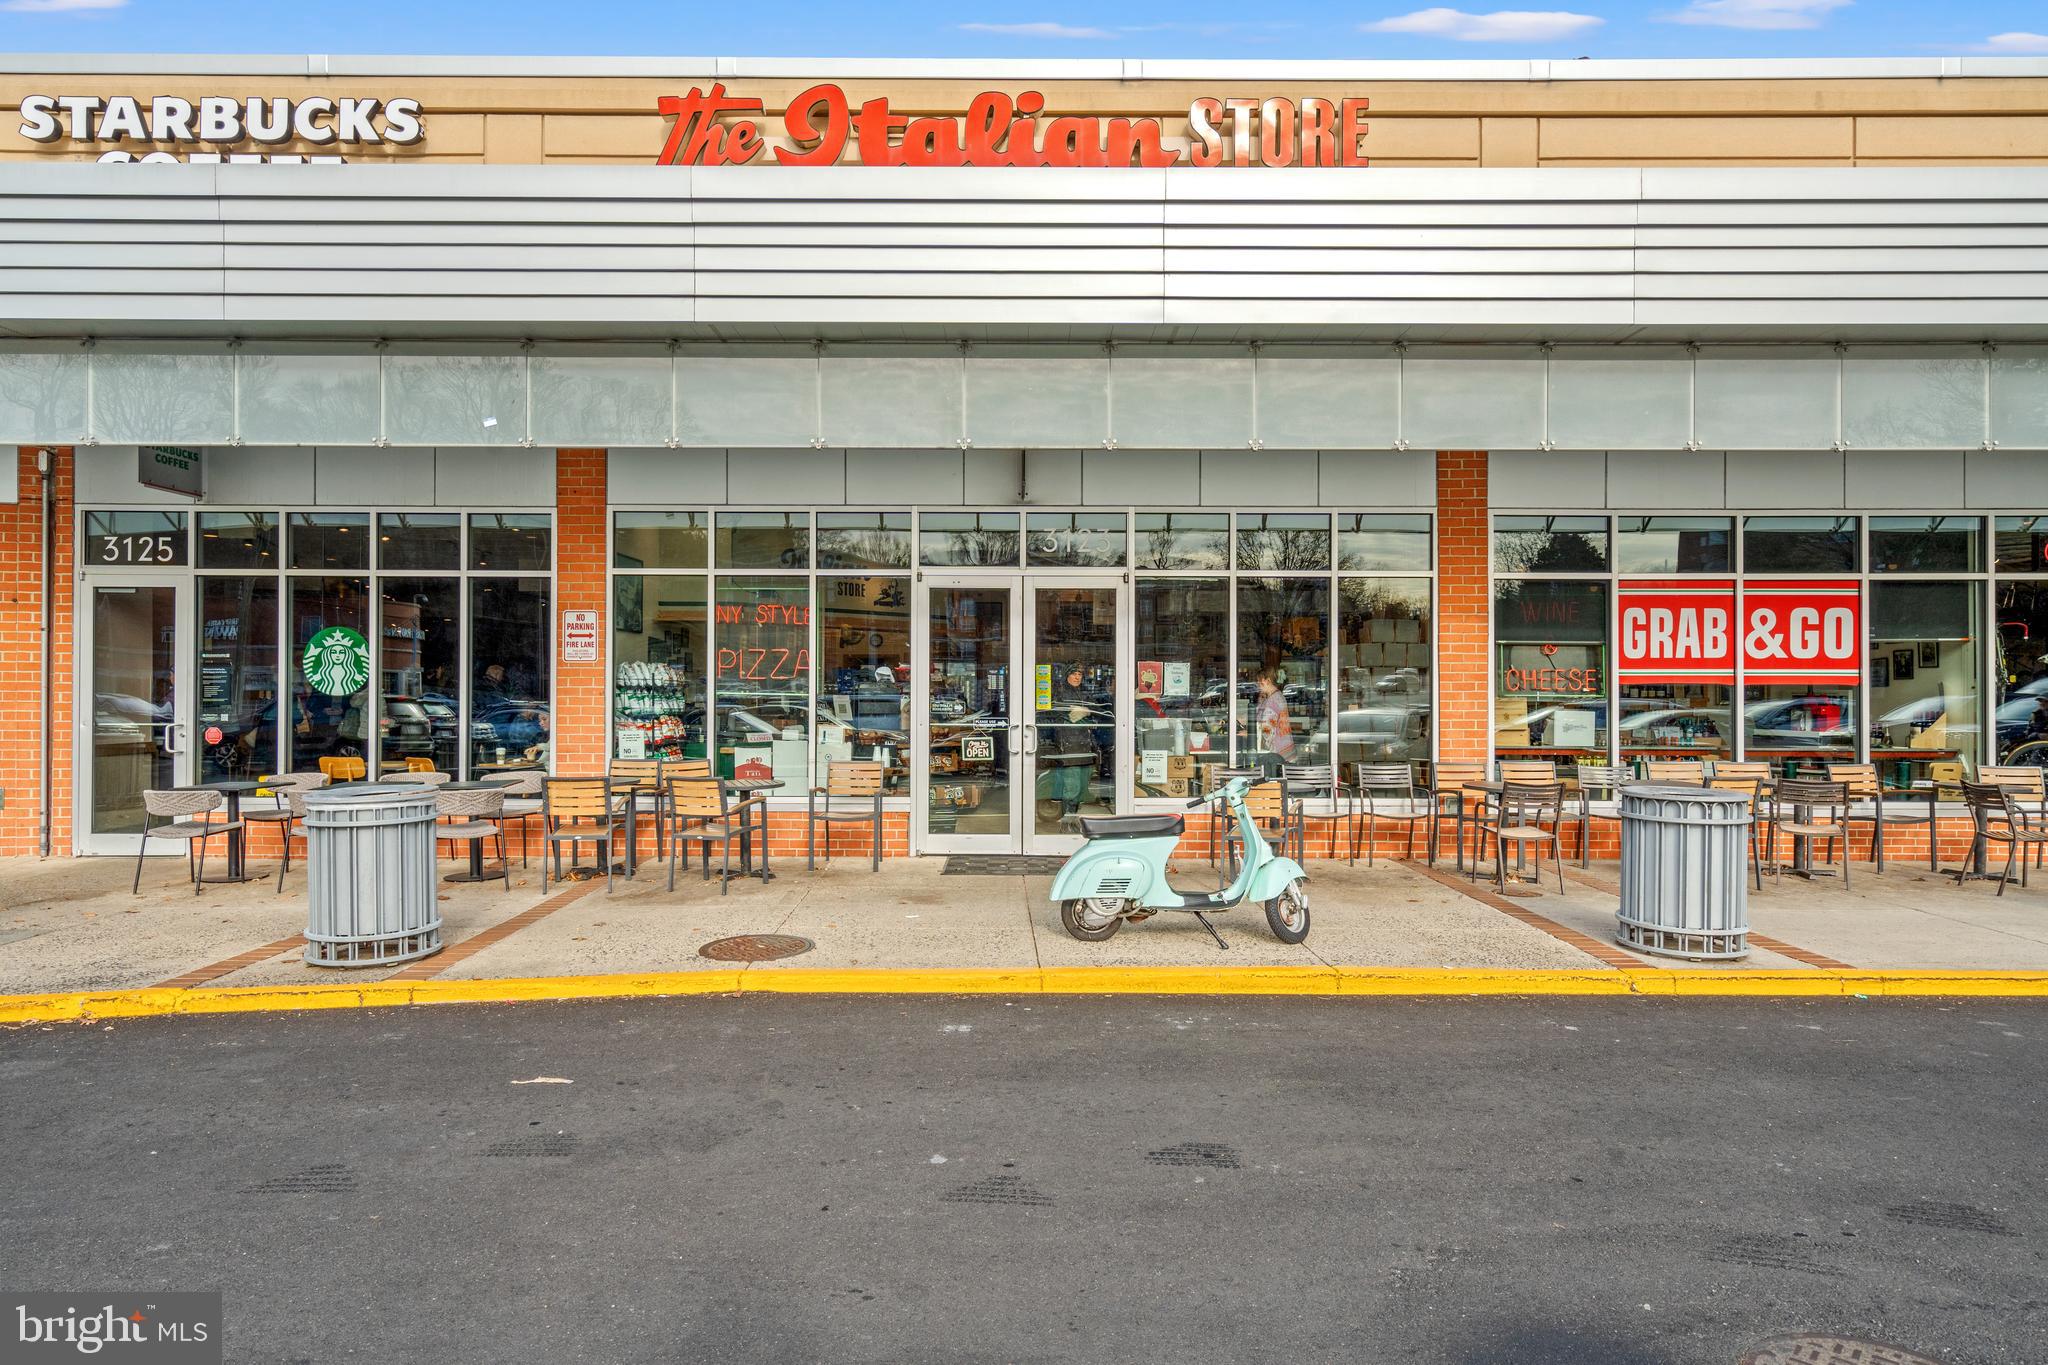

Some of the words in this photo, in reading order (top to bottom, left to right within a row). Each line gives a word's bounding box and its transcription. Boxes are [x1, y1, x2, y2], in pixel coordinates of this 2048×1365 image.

[18, 95, 423, 145] STARBUCKS
[656, 83, 764, 166] The
[774, 84, 1180, 167] Italian
[1188, 96, 1370, 167] STORE
[154, 453, 190, 471] COFFEE
[102, 536, 174, 562] 3125
[1041, 528, 1111, 553] 3123
[837, 582, 866, 597] STORE
[575, 613, 585, 621] NO
[716, 604, 742, 624] NY
[1520, 601, 1581, 624] WINE
[566, 622, 595, 630] PARKING
[1622, 607, 1728, 659] GRAB
[717, 648, 810, 680] PIZZA
[1505, 668, 1598, 692] CHEESE
[966, 748, 990, 758] OPEN
